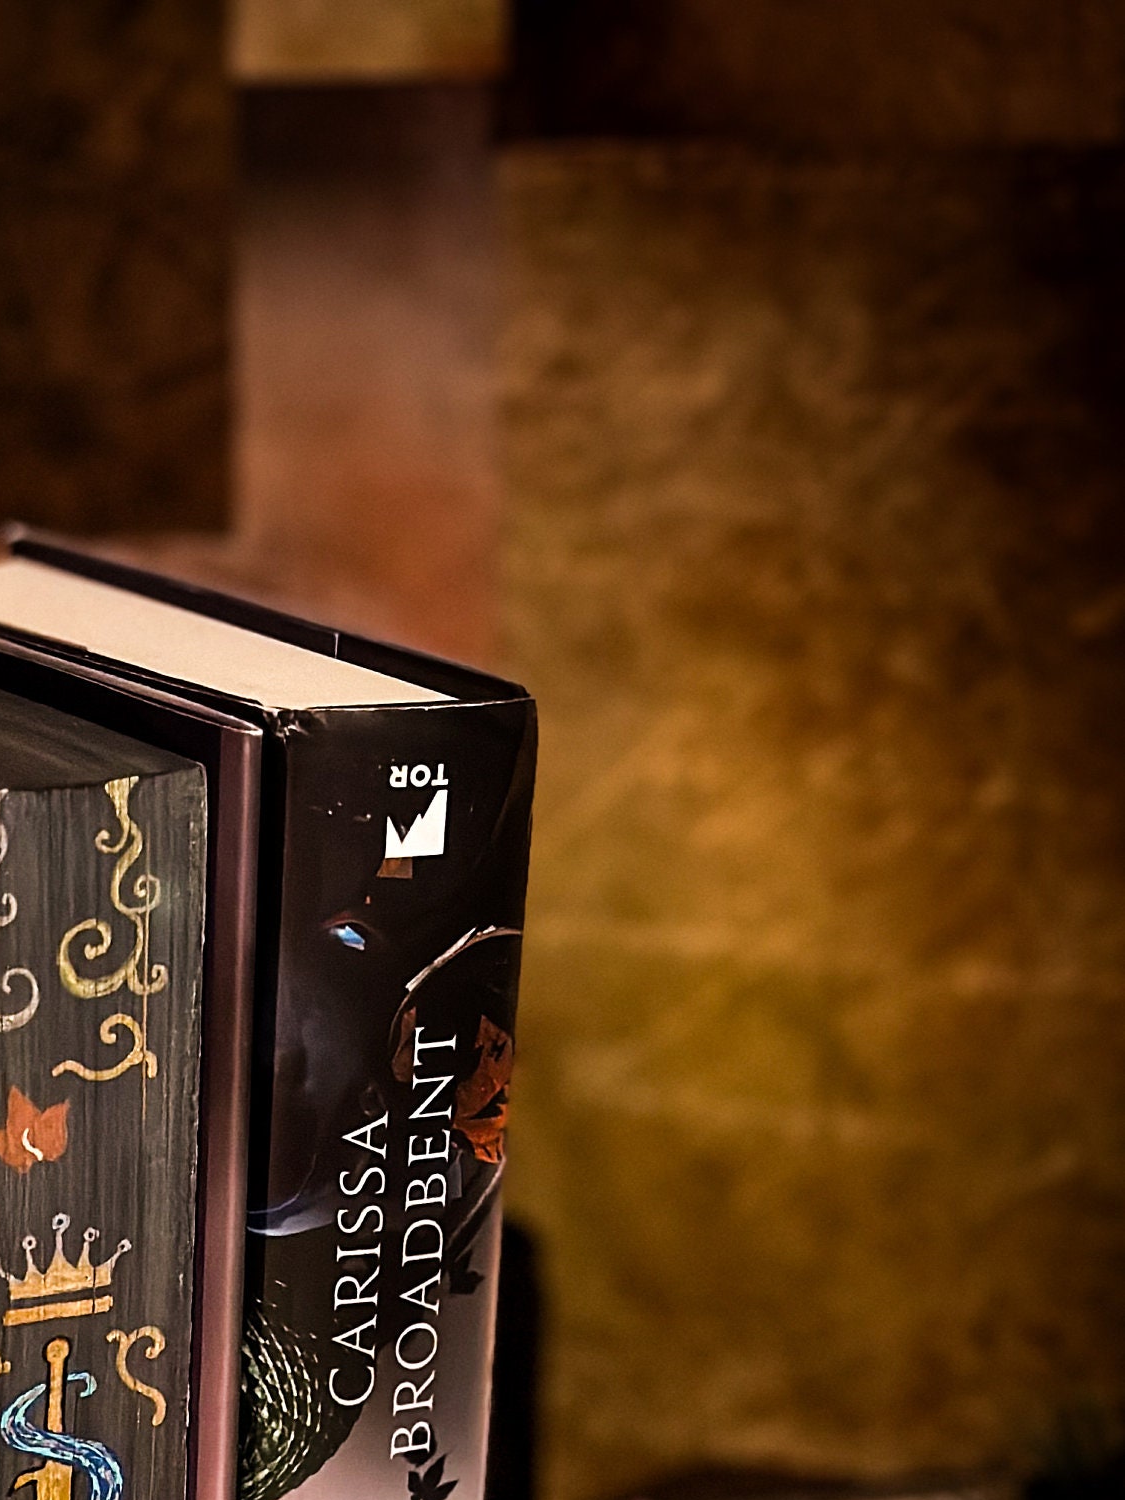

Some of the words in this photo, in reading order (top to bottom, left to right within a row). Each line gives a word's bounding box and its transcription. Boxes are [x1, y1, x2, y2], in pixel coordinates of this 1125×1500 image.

[389, 763, 449, 788] TOR
[329, 1110, 390, 1407] CARISSA
[390, 1027, 458, 1460] BROADBENT
